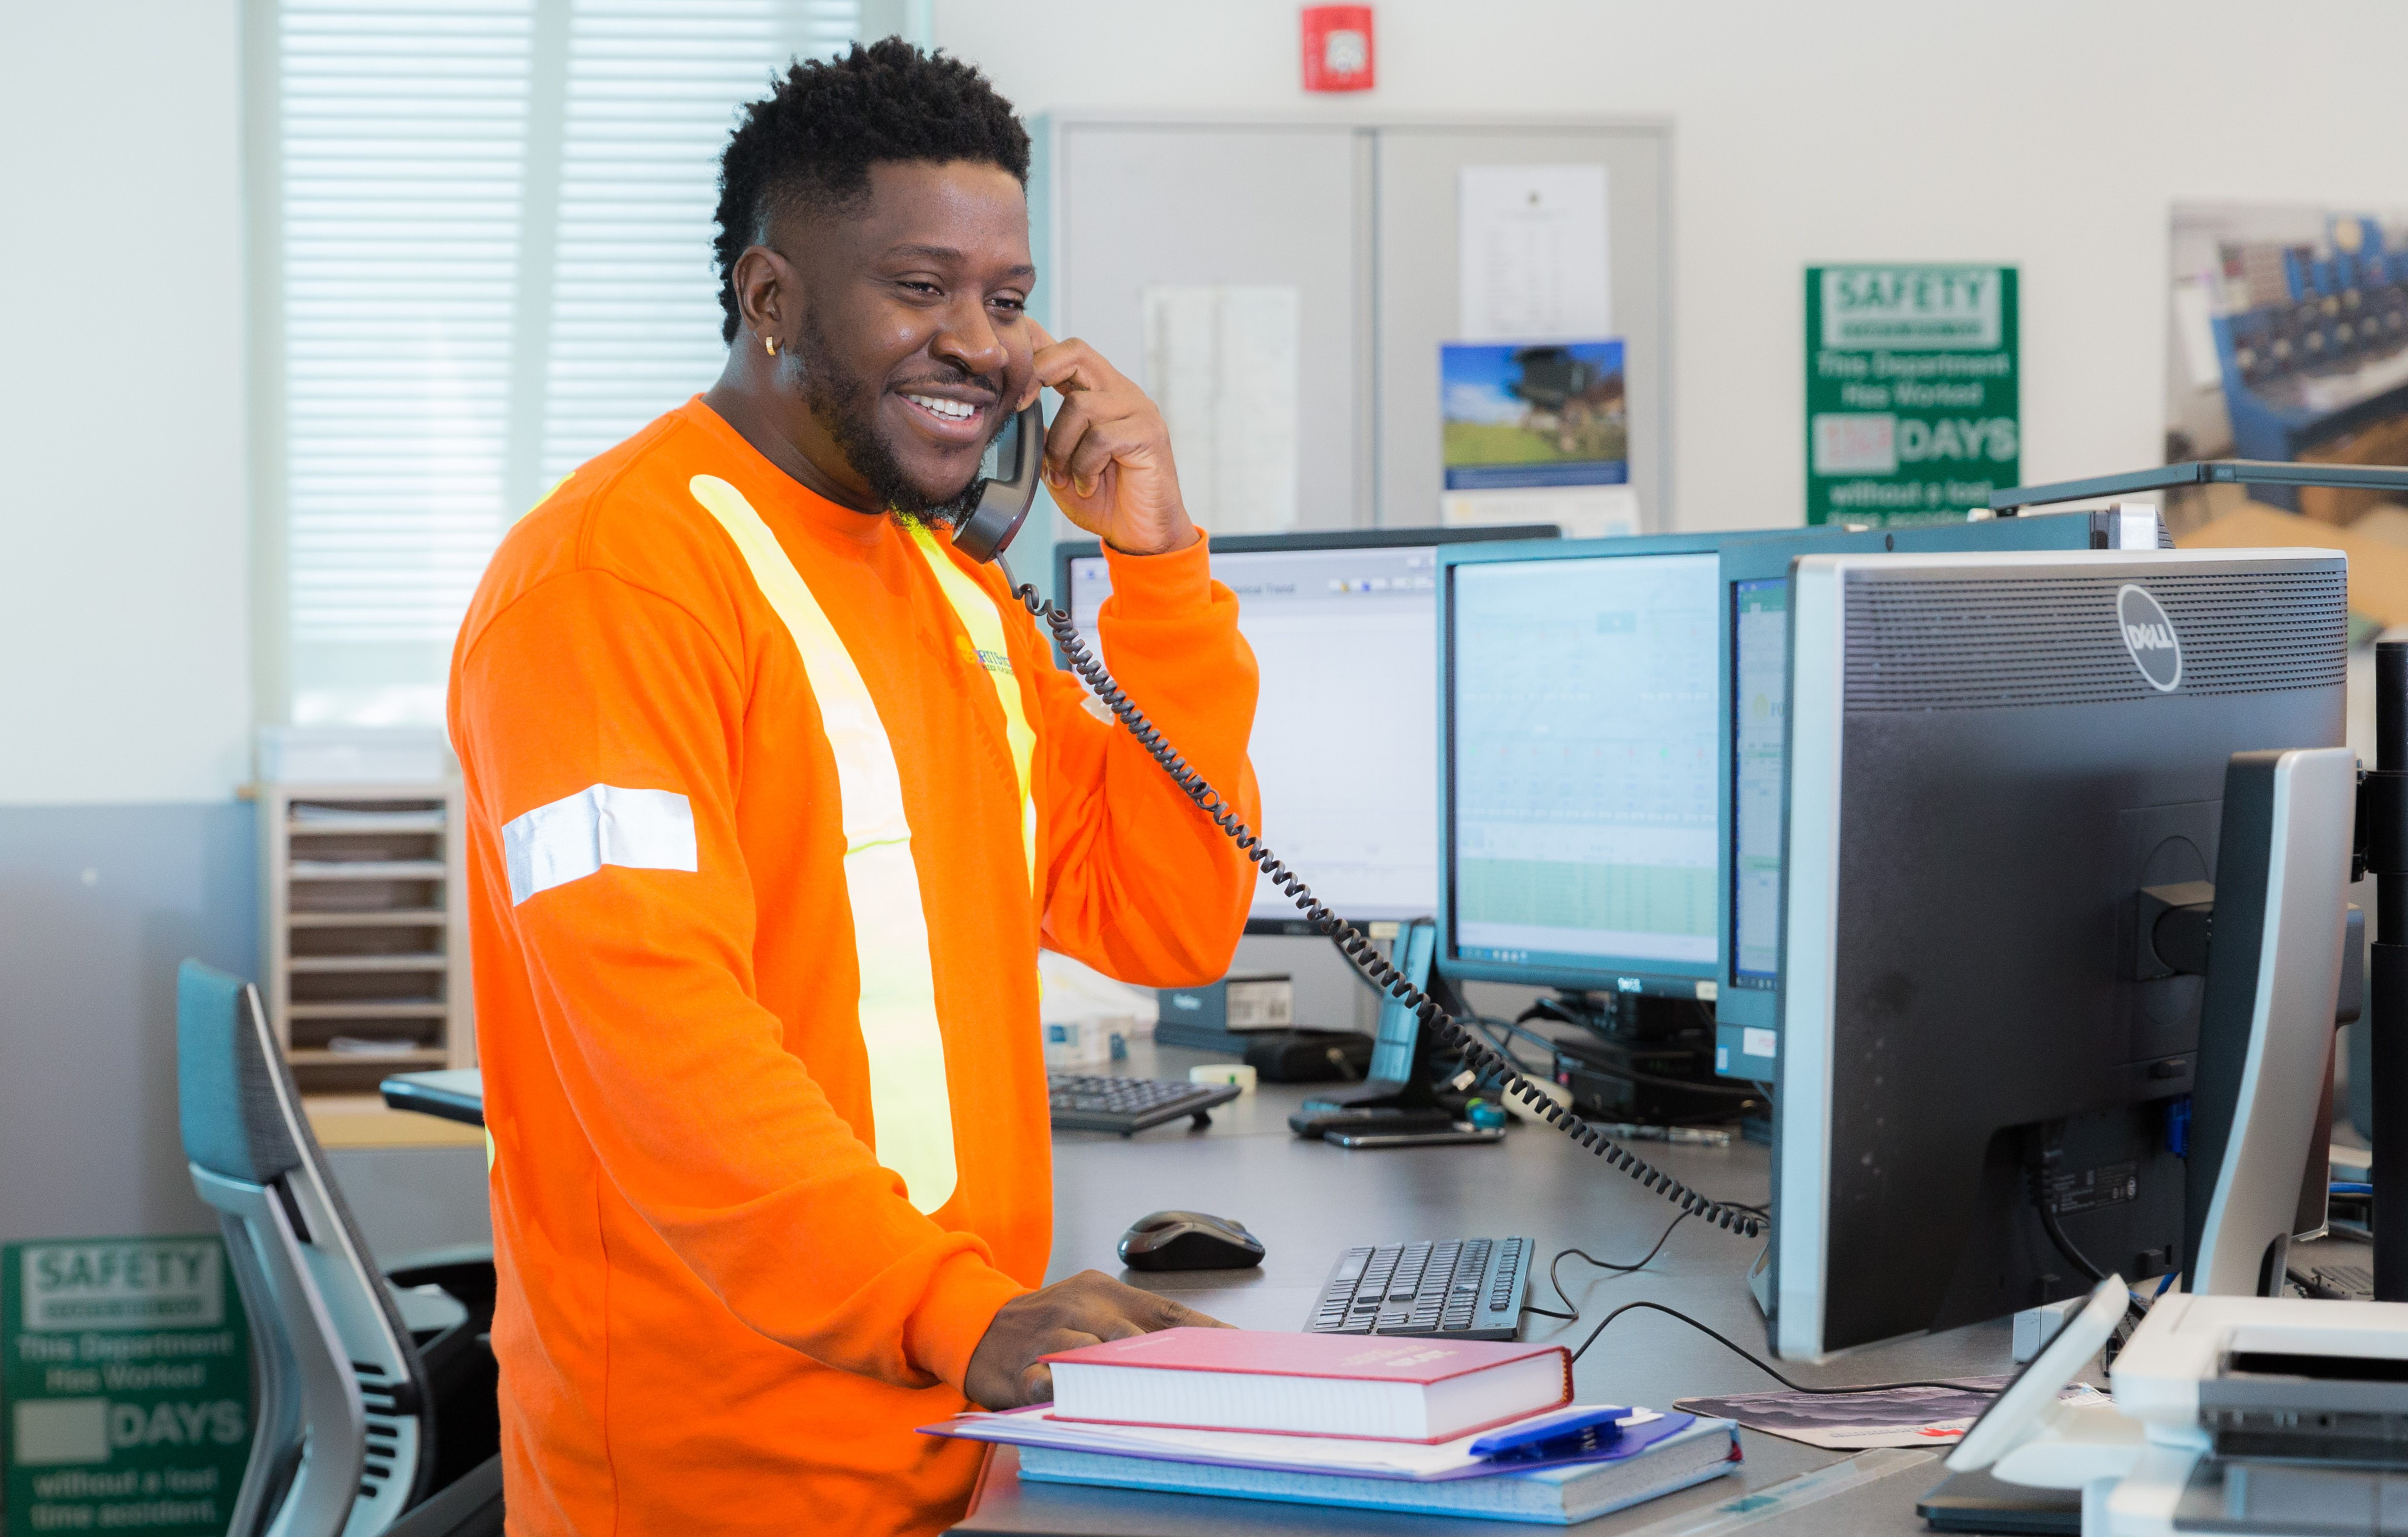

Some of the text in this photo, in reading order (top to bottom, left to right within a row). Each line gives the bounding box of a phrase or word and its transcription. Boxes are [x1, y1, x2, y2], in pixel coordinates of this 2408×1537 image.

[1835, 272, 1985, 312] SAFETY
[1873, 353, 2010, 378] Department
[1899, 417, 2017, 462] DAYS
[1829, 480, 1922, 507] without
[2126, 622, 2174, 650] DELL
[37, 1246, 206, 1292] SAFETY
[79, 1331, 234, 1360] Department
[112, 1399, 244, 1448] DAYS
[33, 1469, 137, 1498] without
